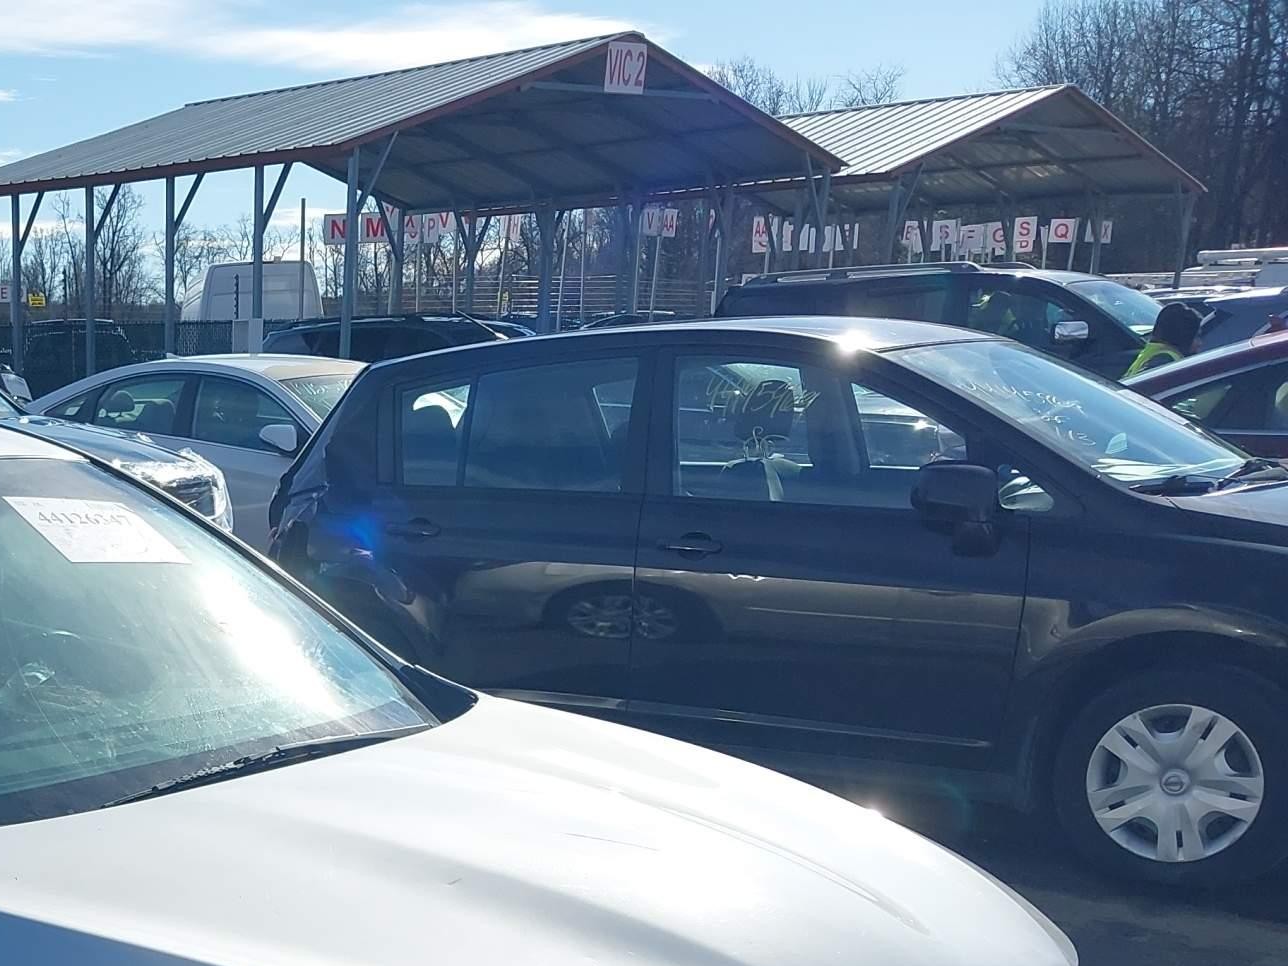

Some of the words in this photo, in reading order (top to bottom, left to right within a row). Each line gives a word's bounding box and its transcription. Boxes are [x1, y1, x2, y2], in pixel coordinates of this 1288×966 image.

[608, 48, 633, 87] VIC
[634, 51, 646, 87] 2
[330, 219, 347, 239] N
[366, 218, 385, 237] M
[663, 211, 675, 233] AA
[1018, 221, 1031, 237] S
[1054, 223, 1069, 239] Q
[1, 287, 8, 300] E
